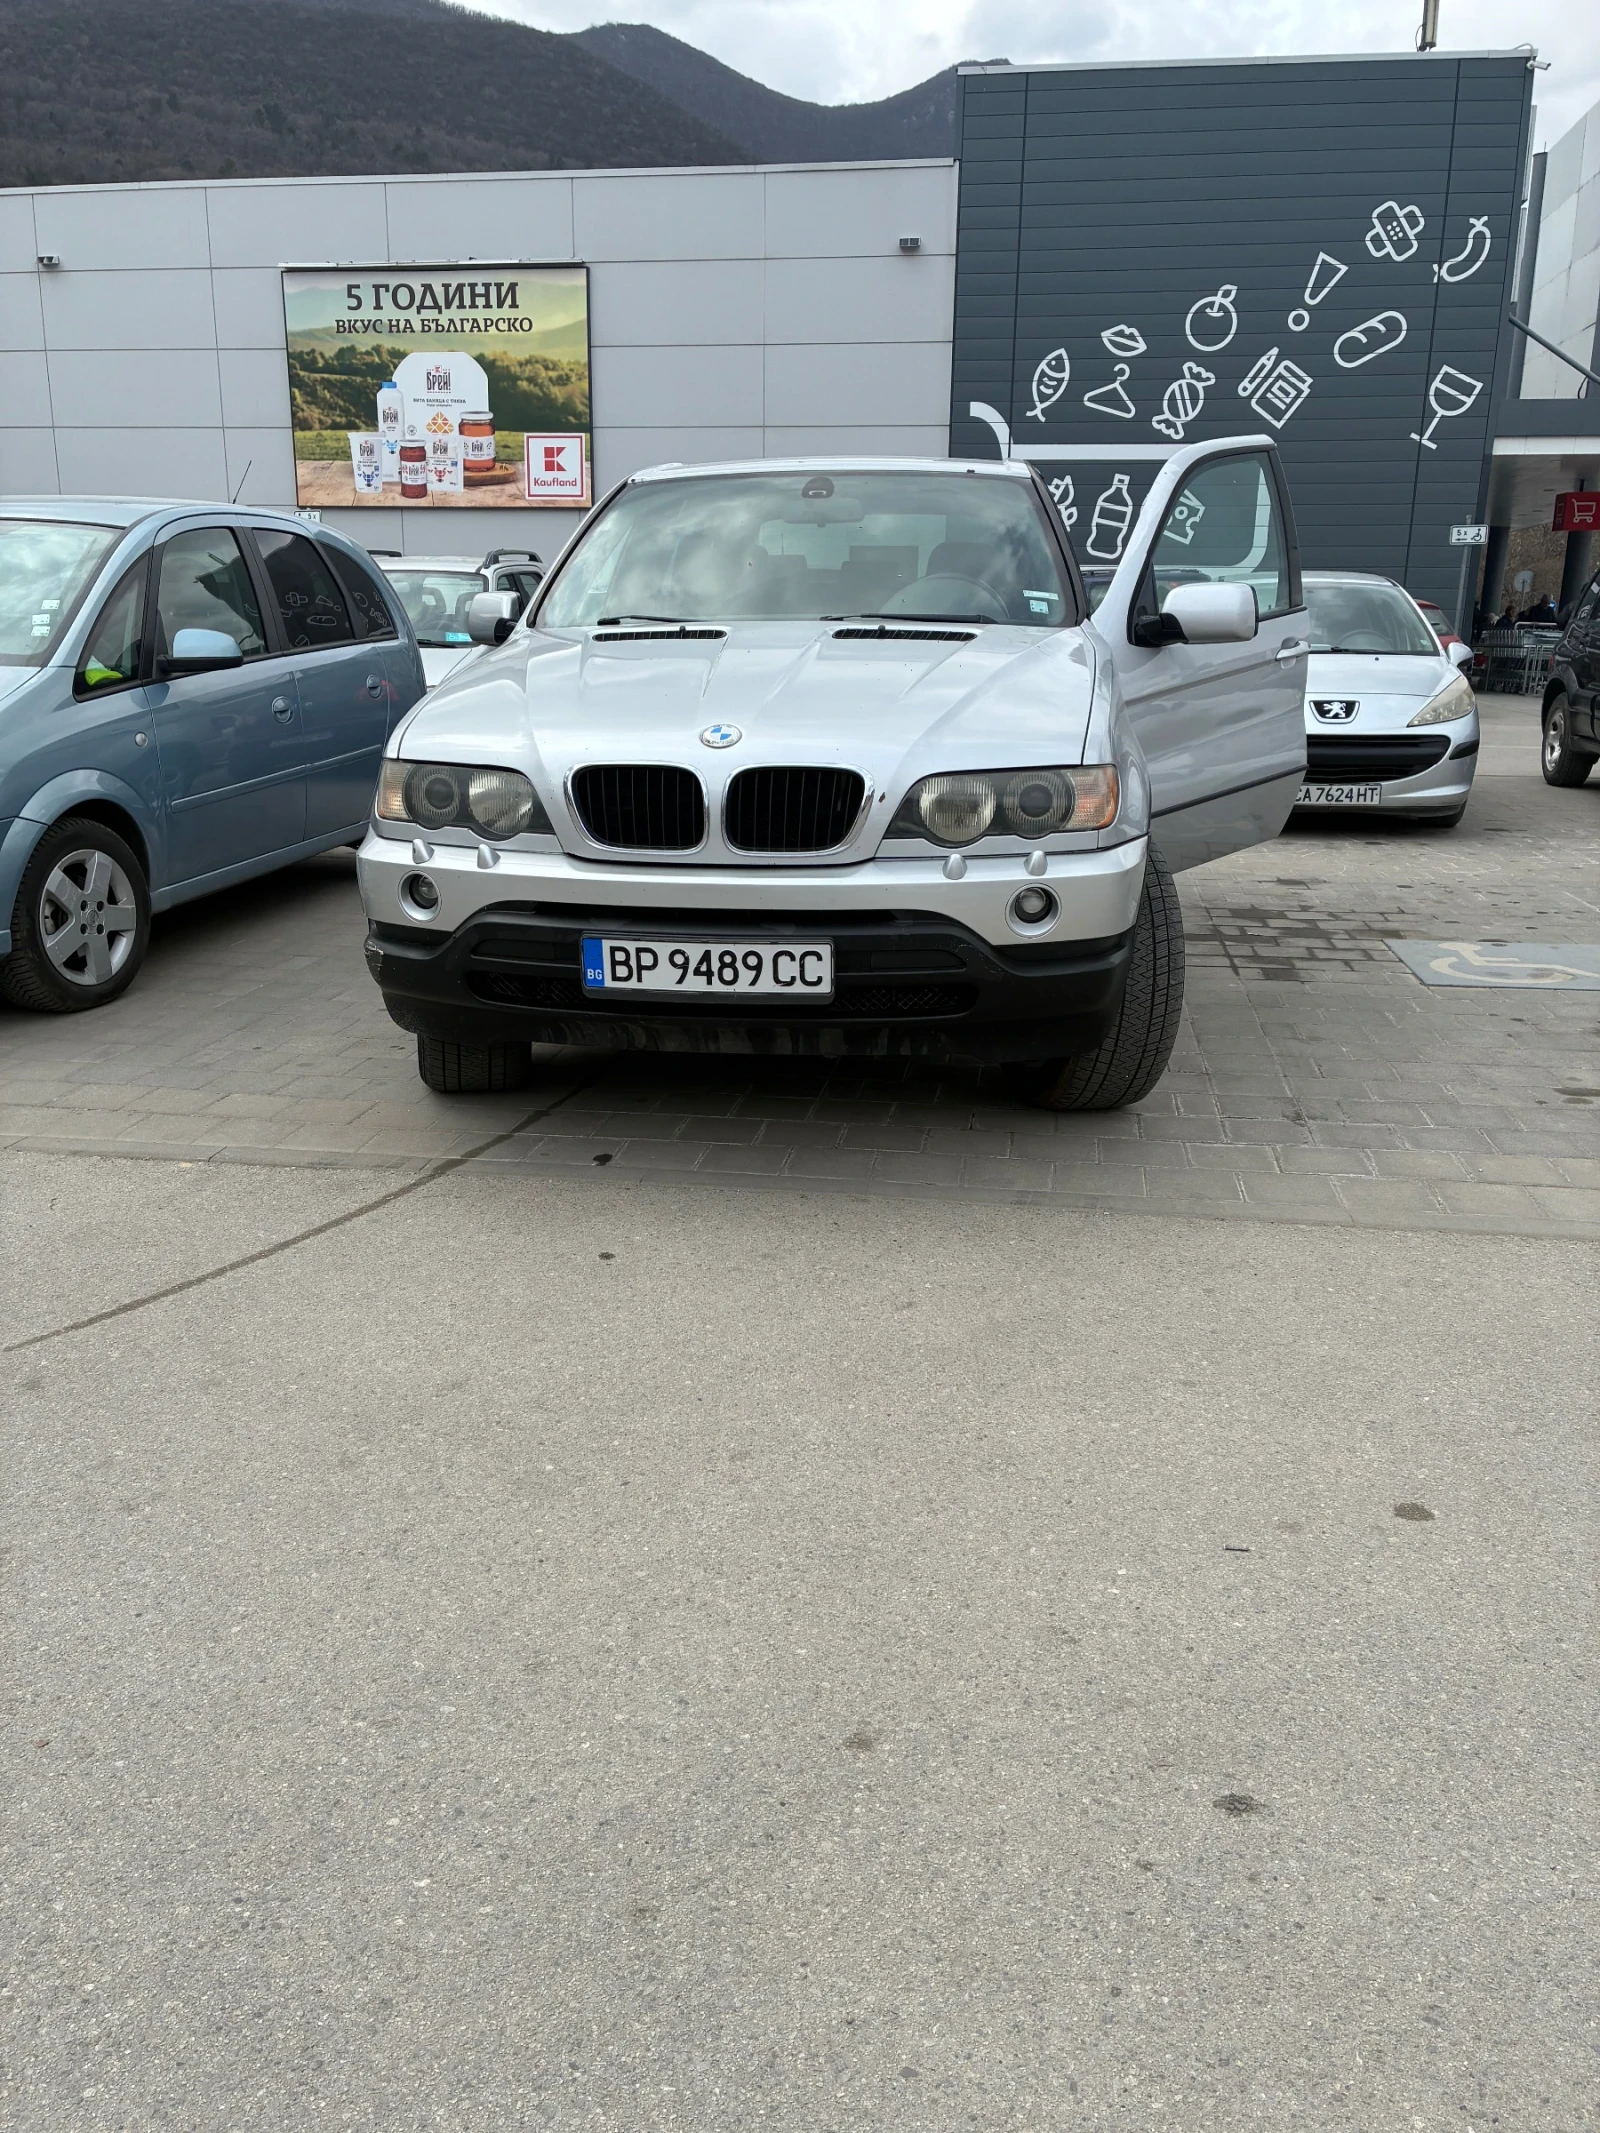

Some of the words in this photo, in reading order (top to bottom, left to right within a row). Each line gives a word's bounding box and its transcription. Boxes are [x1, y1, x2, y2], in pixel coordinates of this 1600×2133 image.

[346, 284, 363, 310] 5
[372, 282, 519, 315] ГОДИНИ
[335, 318, 383, 334] ВКУС
[388, 318, 415, 333] НА
[420, 317, 533, 333] БЪЛГАРСКО
[533, 477, 577, 487] Kaufland
[1315, 787, 1353, 802] 7624
[1357, 787, 1378, 802] HT
[587, 968, 603, 980] BG
[609, 945, 658, 983] BP
[668, 948, 763, 987] 9489
[771, 950, 823, 987] CC
